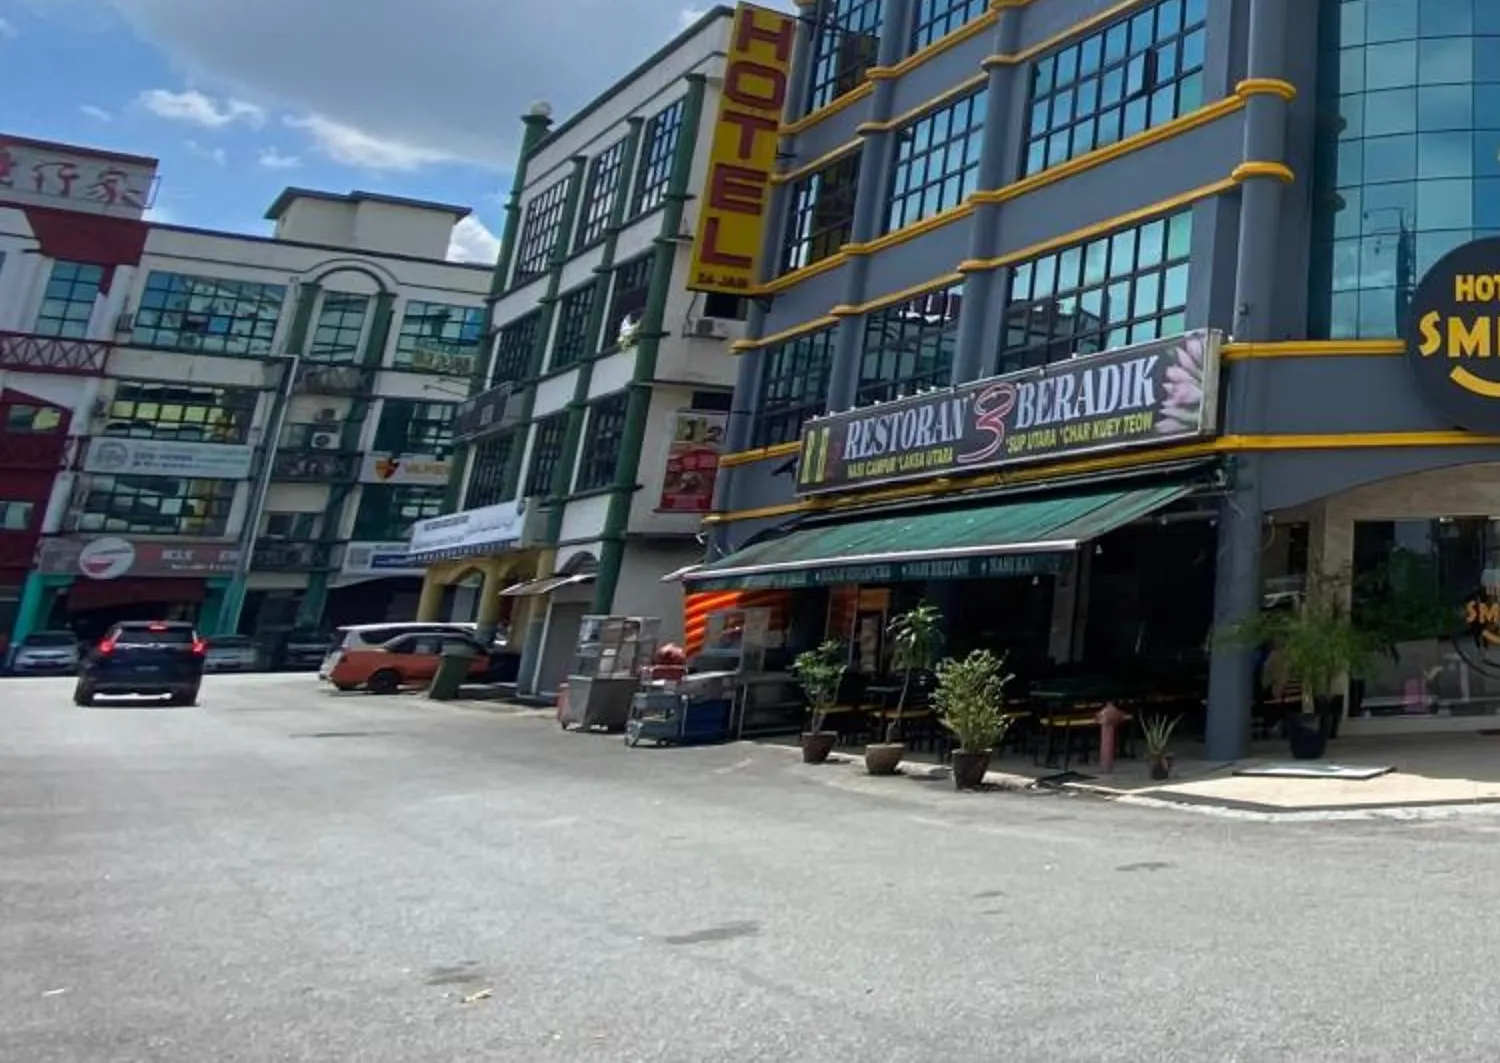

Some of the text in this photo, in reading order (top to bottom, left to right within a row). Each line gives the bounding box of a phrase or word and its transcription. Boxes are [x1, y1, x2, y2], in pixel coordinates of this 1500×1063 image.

[699, 10, 792, 268] HOTEL
[842, 398, 968, 460] RESTORAN
[1015, 354, 1160, 429] BERADIK
